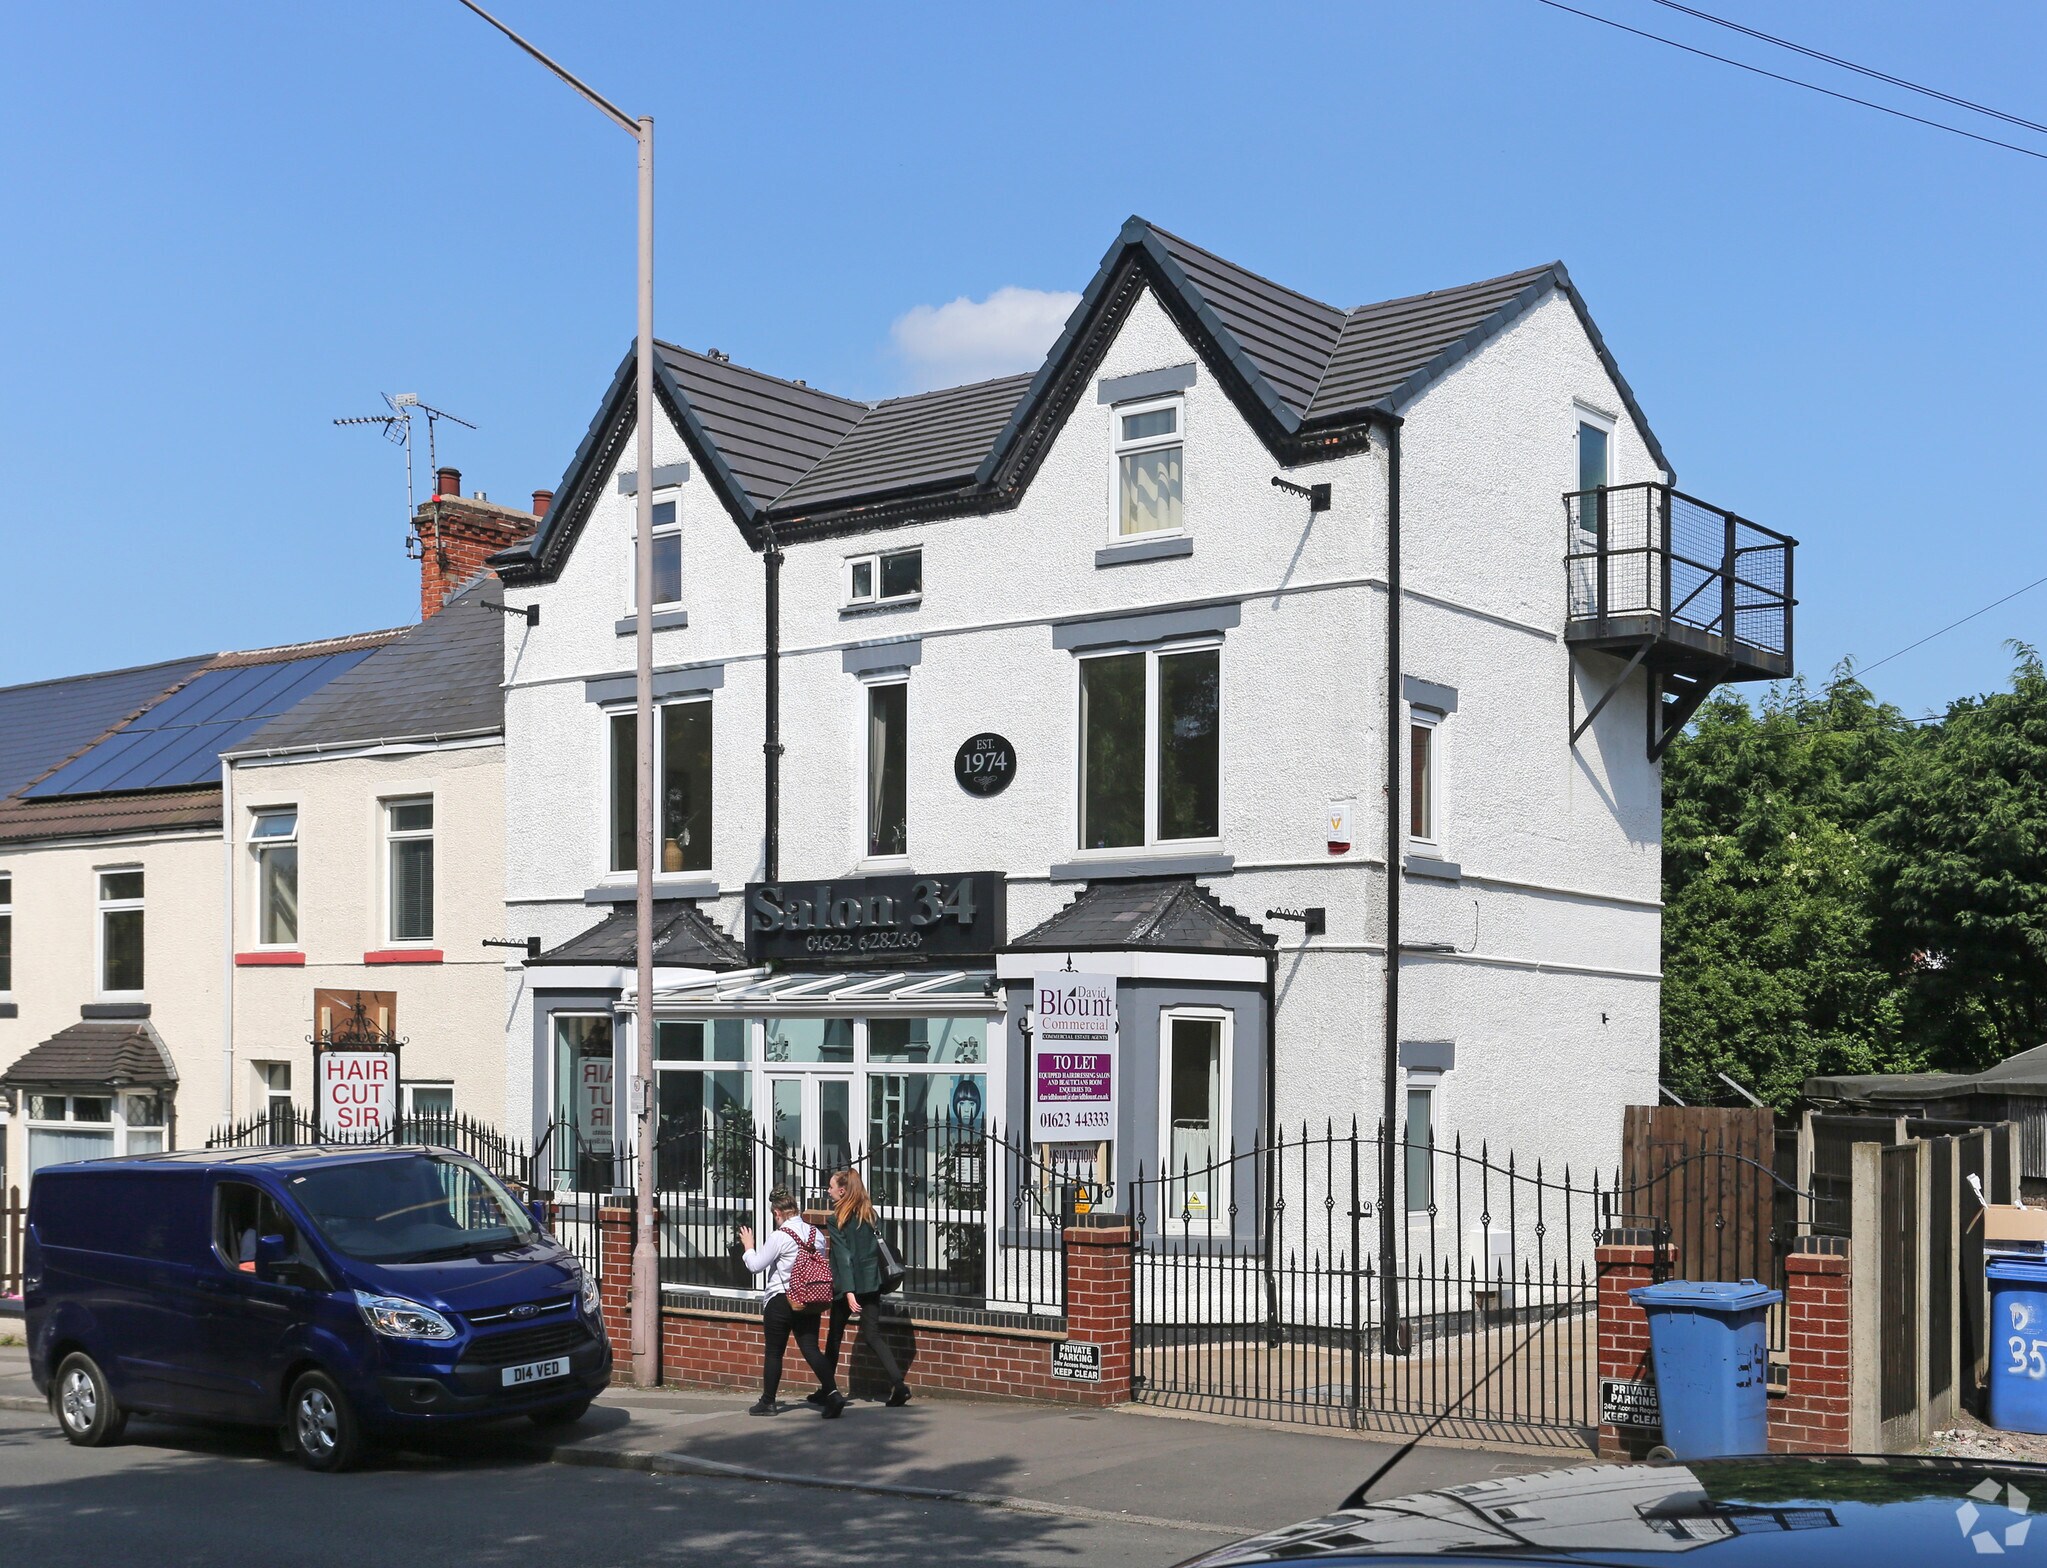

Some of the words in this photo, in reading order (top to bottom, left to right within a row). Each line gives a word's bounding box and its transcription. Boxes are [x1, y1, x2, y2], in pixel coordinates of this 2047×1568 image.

[976, 738, 995, 750] EST.
[964, 751, 1008, 774] 1974
[752, 885, 901, 931] Salon
[910, 878, 976, 926] 34
[806, 935, 852, 952] 01623
[859, 931, 923, 951] 628260
[1078, 985, 1106, 998] David
[1039, 989, 1112, 1016] Blount
[1042, 1017, 1108, 1030] Commercial
[1053, 1055, 1071, 1070] TO
[1074, 1055, 1097, 1070] LET
[327, 1060, 388, 1080] HAIR
[332, 1083, 384, 1104] CUT
[337, 1107, 380, 1128] SIR
[1040, 1112, 1071, 1127] 01623
[1075, 1112, 1109, 1127] 443333
[1060, 1344, 1091, 1354] PRIVATE
[1059, 1352, 1092, 1363] PARKING
[536, 1361, 559, 1377] VED
[1054, 1367, 1072, 1376] KEEP
[1074, 1369, 1098, 1379] CLEAR
[1612, 1384, 1656, 1397] PRIVATE
[1603, 1402, 1617, 1410] 24hr
[1610, 1393, 1658, 1406] PARKING
[1604, 1411, 1629, 1422] KEEP
